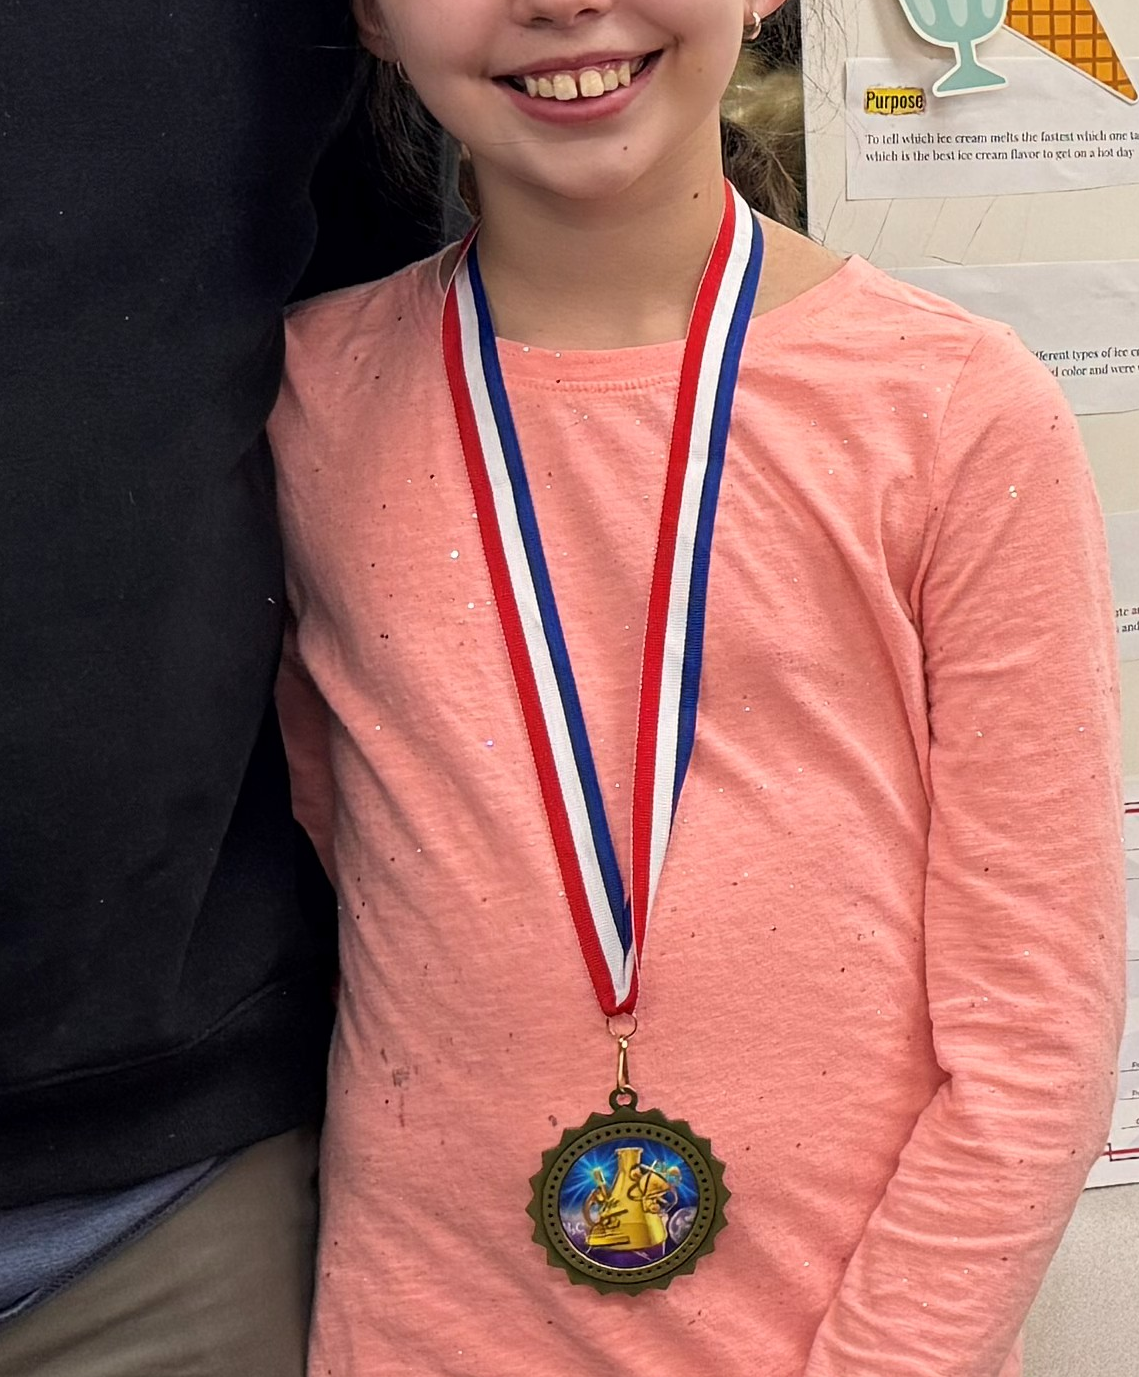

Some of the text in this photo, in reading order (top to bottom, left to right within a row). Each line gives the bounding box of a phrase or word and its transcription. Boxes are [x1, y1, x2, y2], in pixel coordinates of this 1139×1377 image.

[866, 91, 924, 114] Purpose
[865, 134, 879, 144] To
[882, 133, 899, 144] tell
[902, 133, 934, 144] which
[937, 132, 952, 143] ice
[955, 134, 987, 143] cream
[990, 132, 1019, 143] melts
[1022, 131, 1037, 142] the
[1041, 131, 1074, 142] fastest
[1077, 130, 1107, 141] which
[1109, 132, 1127, 141] one
[865, 147, 1135, 162] which is the best ice cream flavor to get on a hot day
[1072, 350, 1099, 362] types
[1101, 346, 1112, 358] of
[1114, 347, 1129, 358] ice
[1062, 365, 1087, 377] color
[1089, 364, 1108, 375] and
[1111, 365, 1135, 375] were
